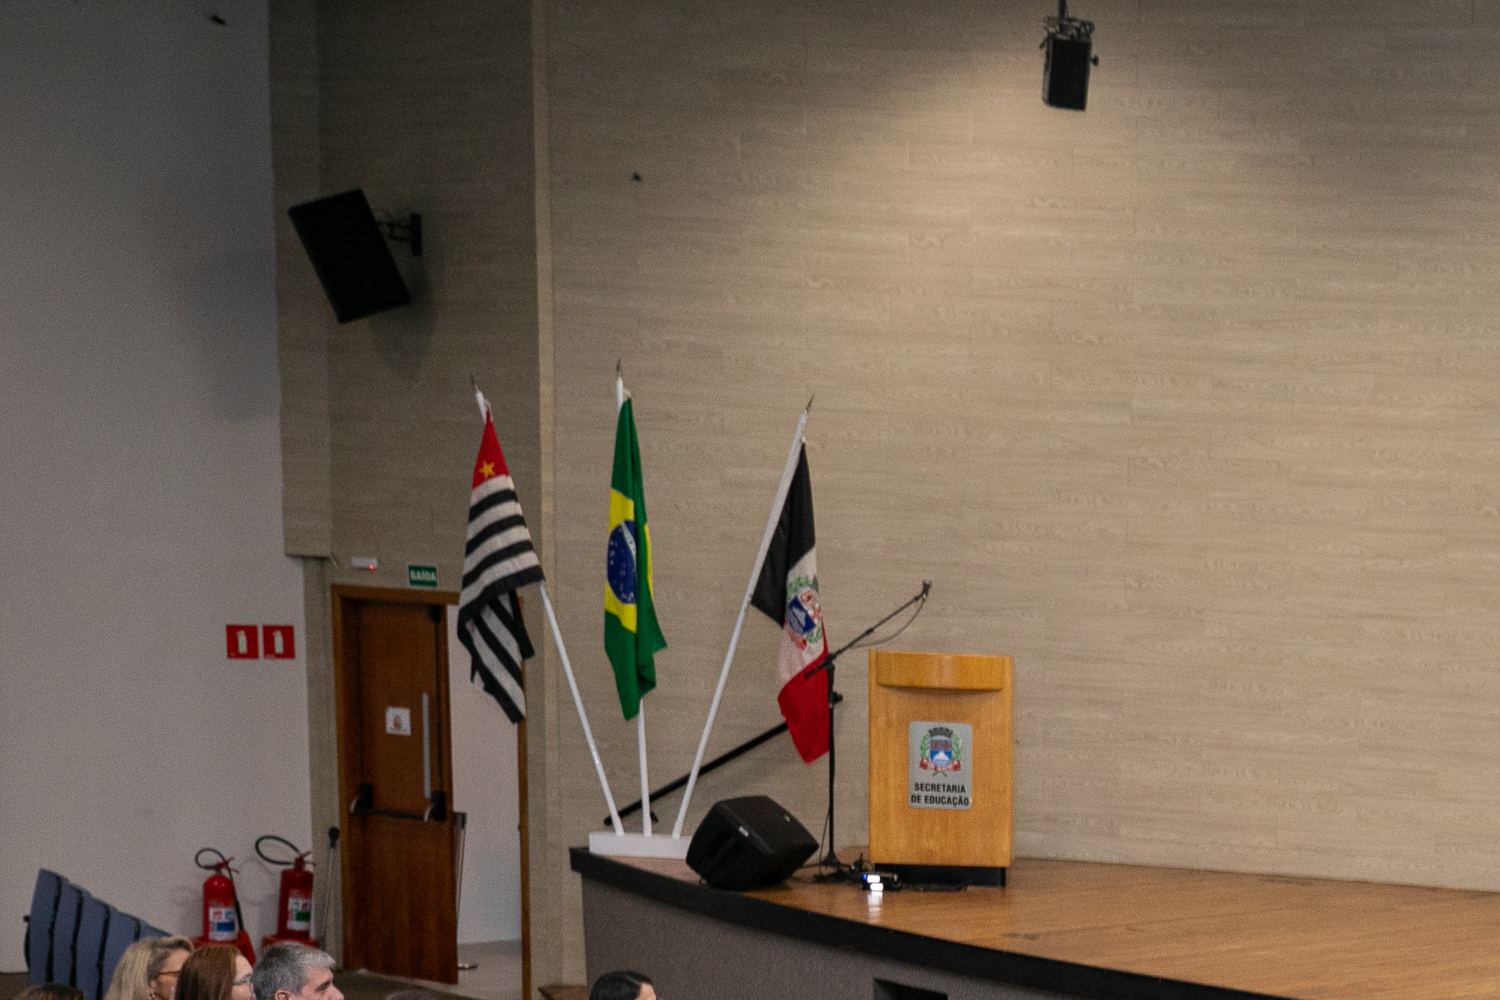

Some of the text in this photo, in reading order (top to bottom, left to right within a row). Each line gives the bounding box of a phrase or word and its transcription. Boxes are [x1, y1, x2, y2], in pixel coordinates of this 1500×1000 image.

[410, 569, 437, 582] SAÍDA
[914, 783, 966, 793] SECRETARIA
[911, 794, 970, 807] DE EDUCAÇÃO
